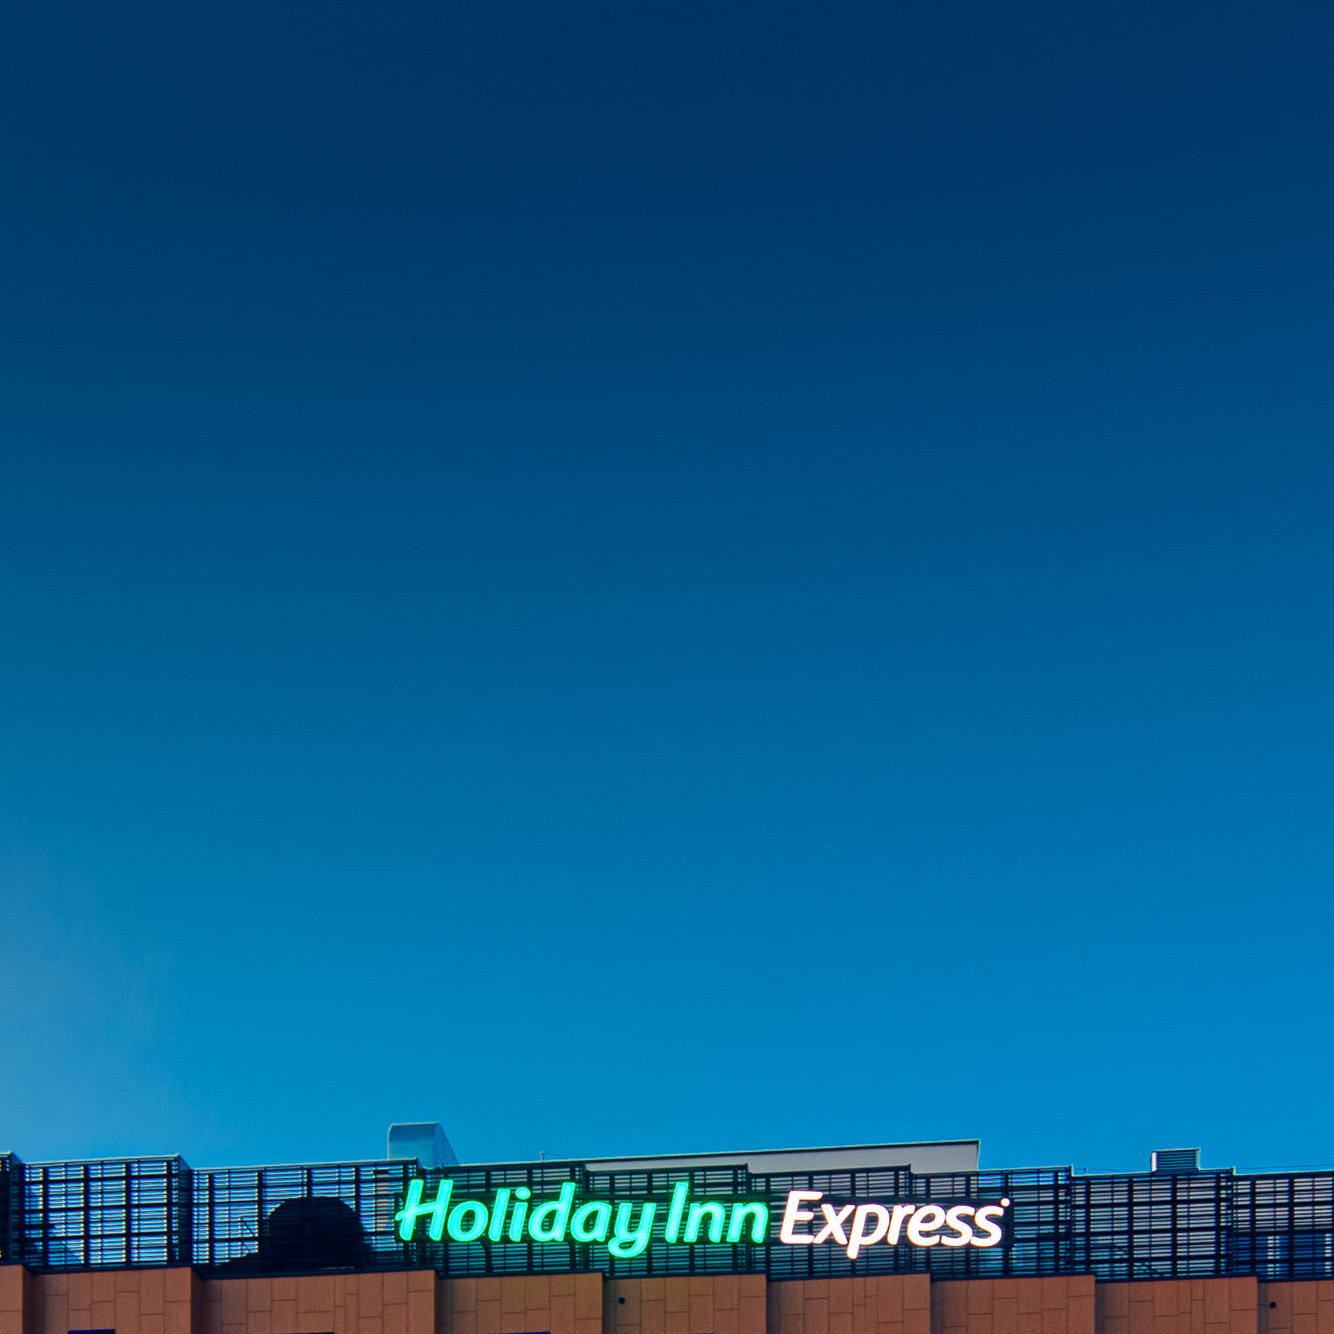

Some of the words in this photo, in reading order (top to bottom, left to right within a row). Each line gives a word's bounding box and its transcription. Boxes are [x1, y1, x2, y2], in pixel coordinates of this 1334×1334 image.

[394, 1178, 657, 1258] Holiday
[664, 1180, 769, 1244] Inn
[779, 1190, 1005, 1260] Express
